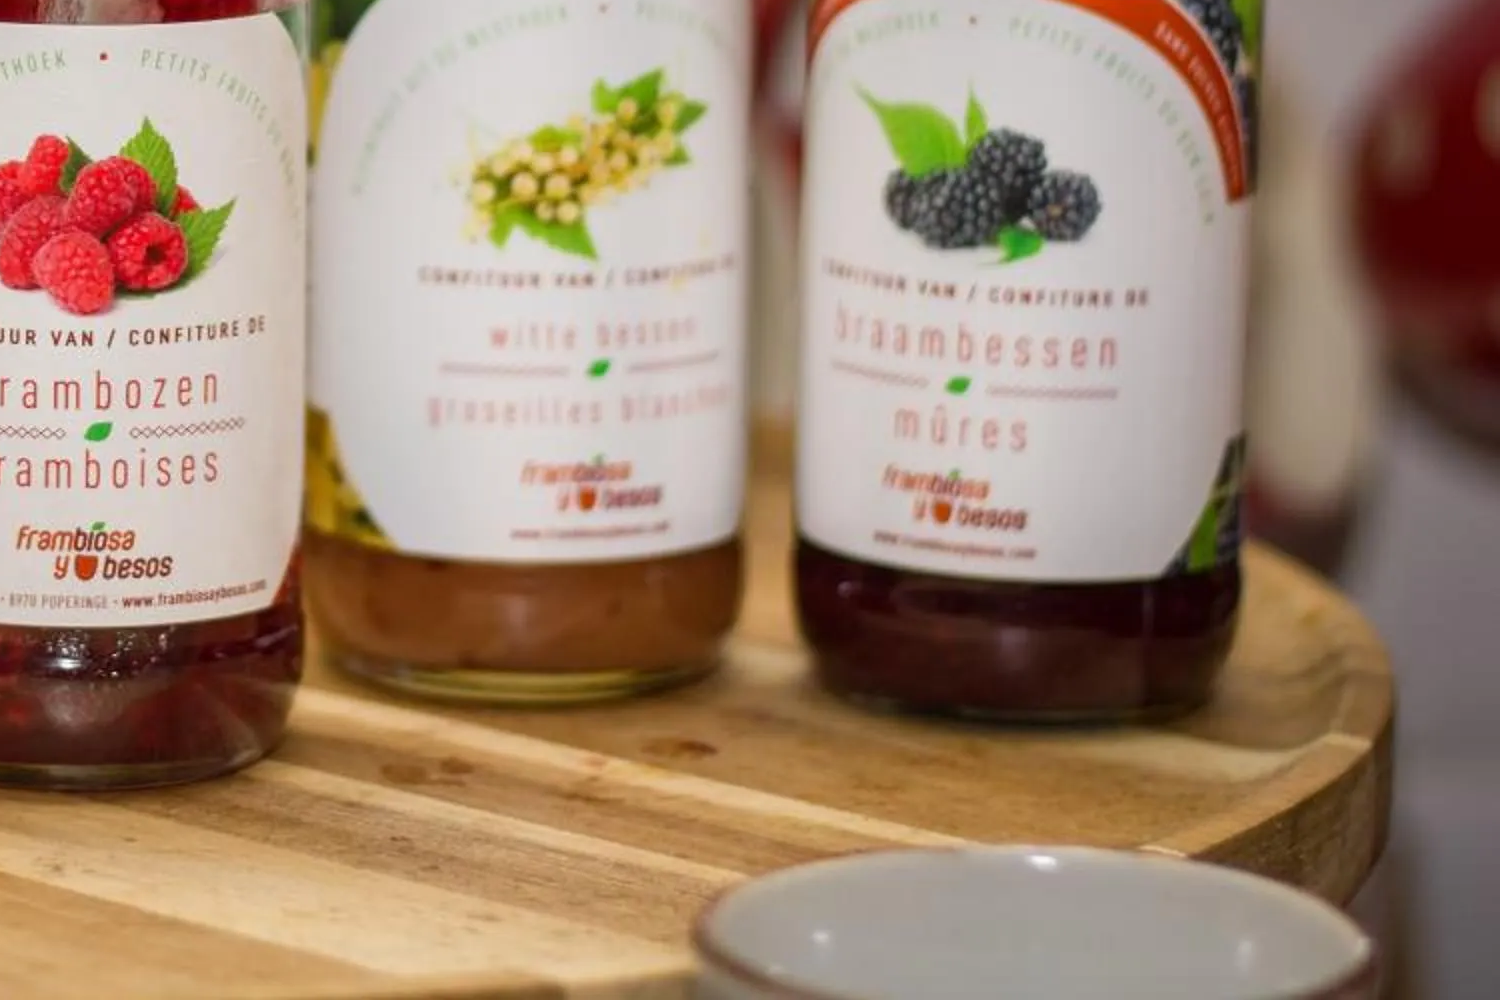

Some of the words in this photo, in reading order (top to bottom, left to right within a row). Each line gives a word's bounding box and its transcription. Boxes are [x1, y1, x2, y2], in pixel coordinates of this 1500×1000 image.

[140, 48, 211, 81] PETITS
[52, 330, 94, 347] VAN
[107, 329, 116, 348] /
[128, 320, 240, 346] CONFITURE
[248, 315, 266, 334] DE
[834, 298, 1116, 368] braambessen
[894, 403, 1027, 451] mûres
[16, 525, 135, 552] frambiosa
[53, 555, 69, 580] y
[102, 555, 173, 581] besos
